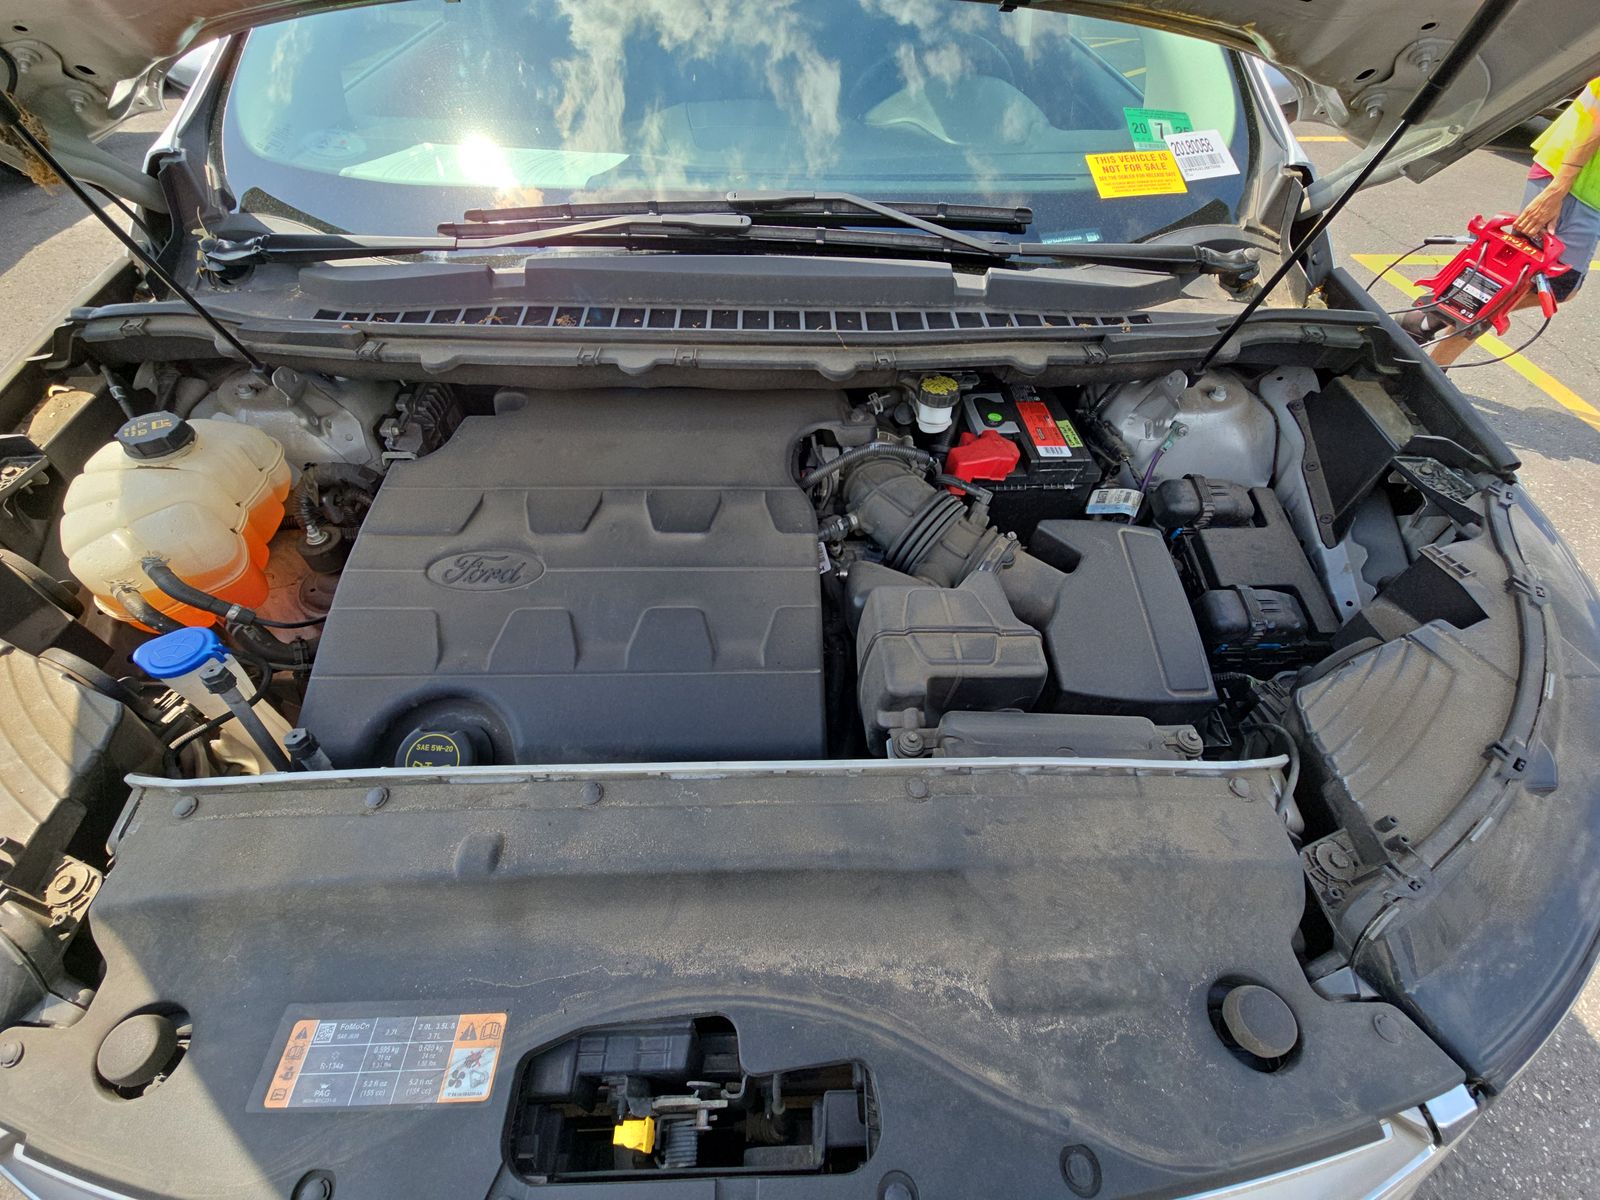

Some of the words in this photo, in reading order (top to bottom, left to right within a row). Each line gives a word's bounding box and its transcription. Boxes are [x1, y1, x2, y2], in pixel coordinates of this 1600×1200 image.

[1131, 122, 1148, 134] 20
[1154, 122, 1164, 140] 7
[1094, 155, 1117, 165] THIS
[1117, 153, 1158, 163] VEHICLE
[1158, 152, 1169, 161] IS
[1102, 164, 1121, 174] NOT
[1123, 163, 1143, 173] FOR
[1144, 162, 1168, 171] SALE
[441, 554, 527, 584] Ford
[416, 743, 430, 751] SAE
[430, 744, 454, 753] 5W-20
[313, 1089, 331, 1097] PAG
